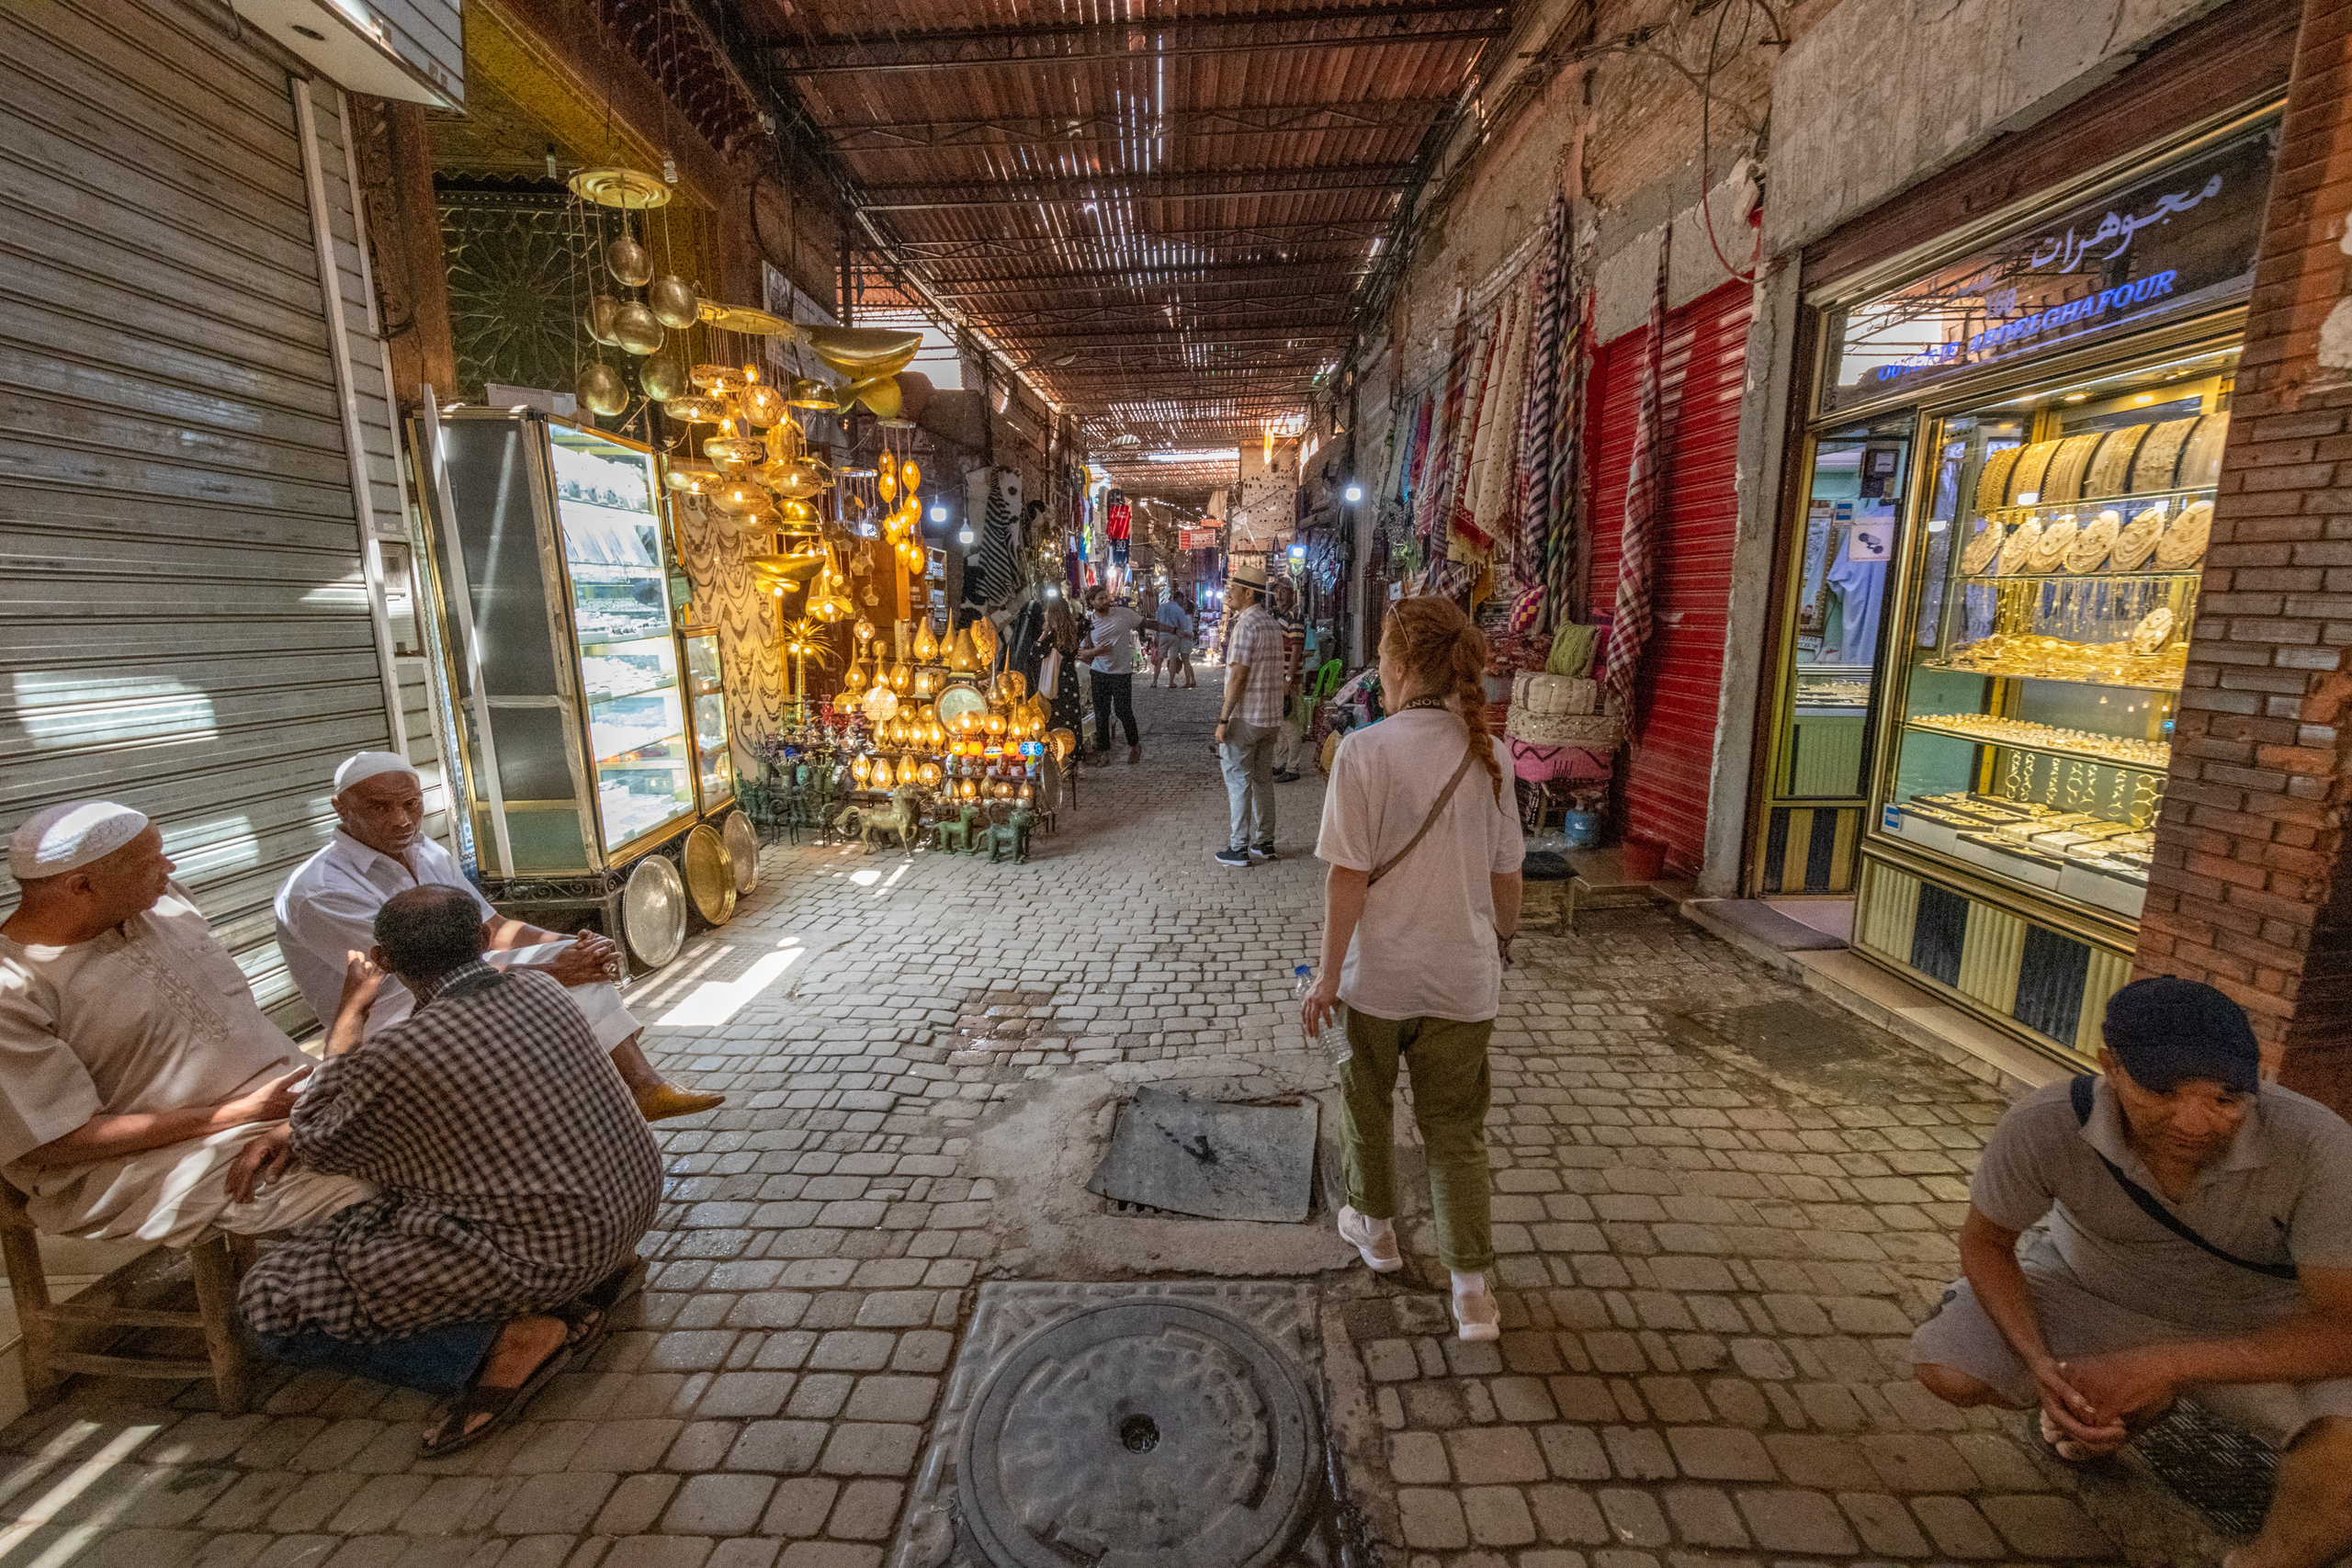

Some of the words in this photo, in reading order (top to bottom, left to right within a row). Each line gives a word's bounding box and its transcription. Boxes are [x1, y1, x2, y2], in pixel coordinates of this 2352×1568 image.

[2030, 174, 2223, 275] مجوهرات
[1966, 269, 2177, 355] ABDELGHAFOUR
[1115, 539, 1126, 550] 30
